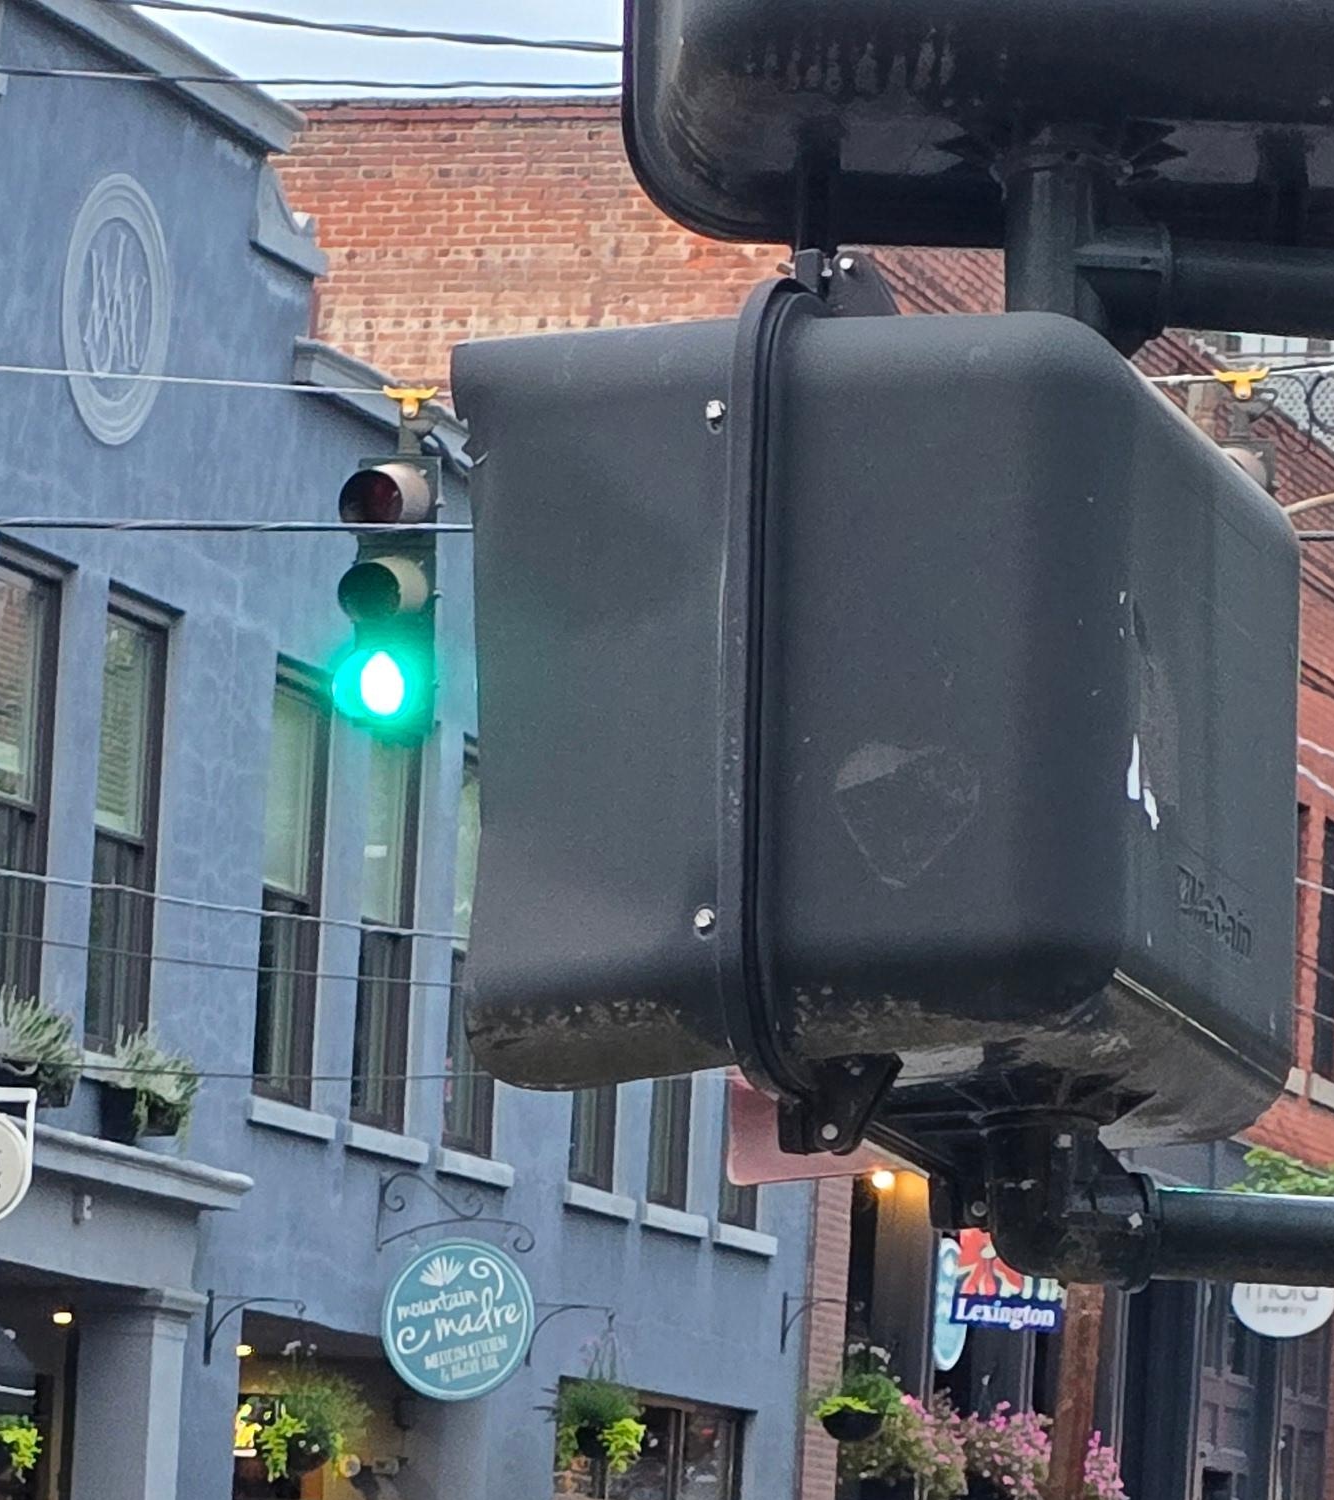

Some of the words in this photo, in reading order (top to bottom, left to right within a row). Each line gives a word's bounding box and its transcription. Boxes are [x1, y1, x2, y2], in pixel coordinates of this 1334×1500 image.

[396, 1286, 479, 1322] mountain
[434, 1286, 523, 1343] madre
[954, 1298, 1056, 1331] Lexington
